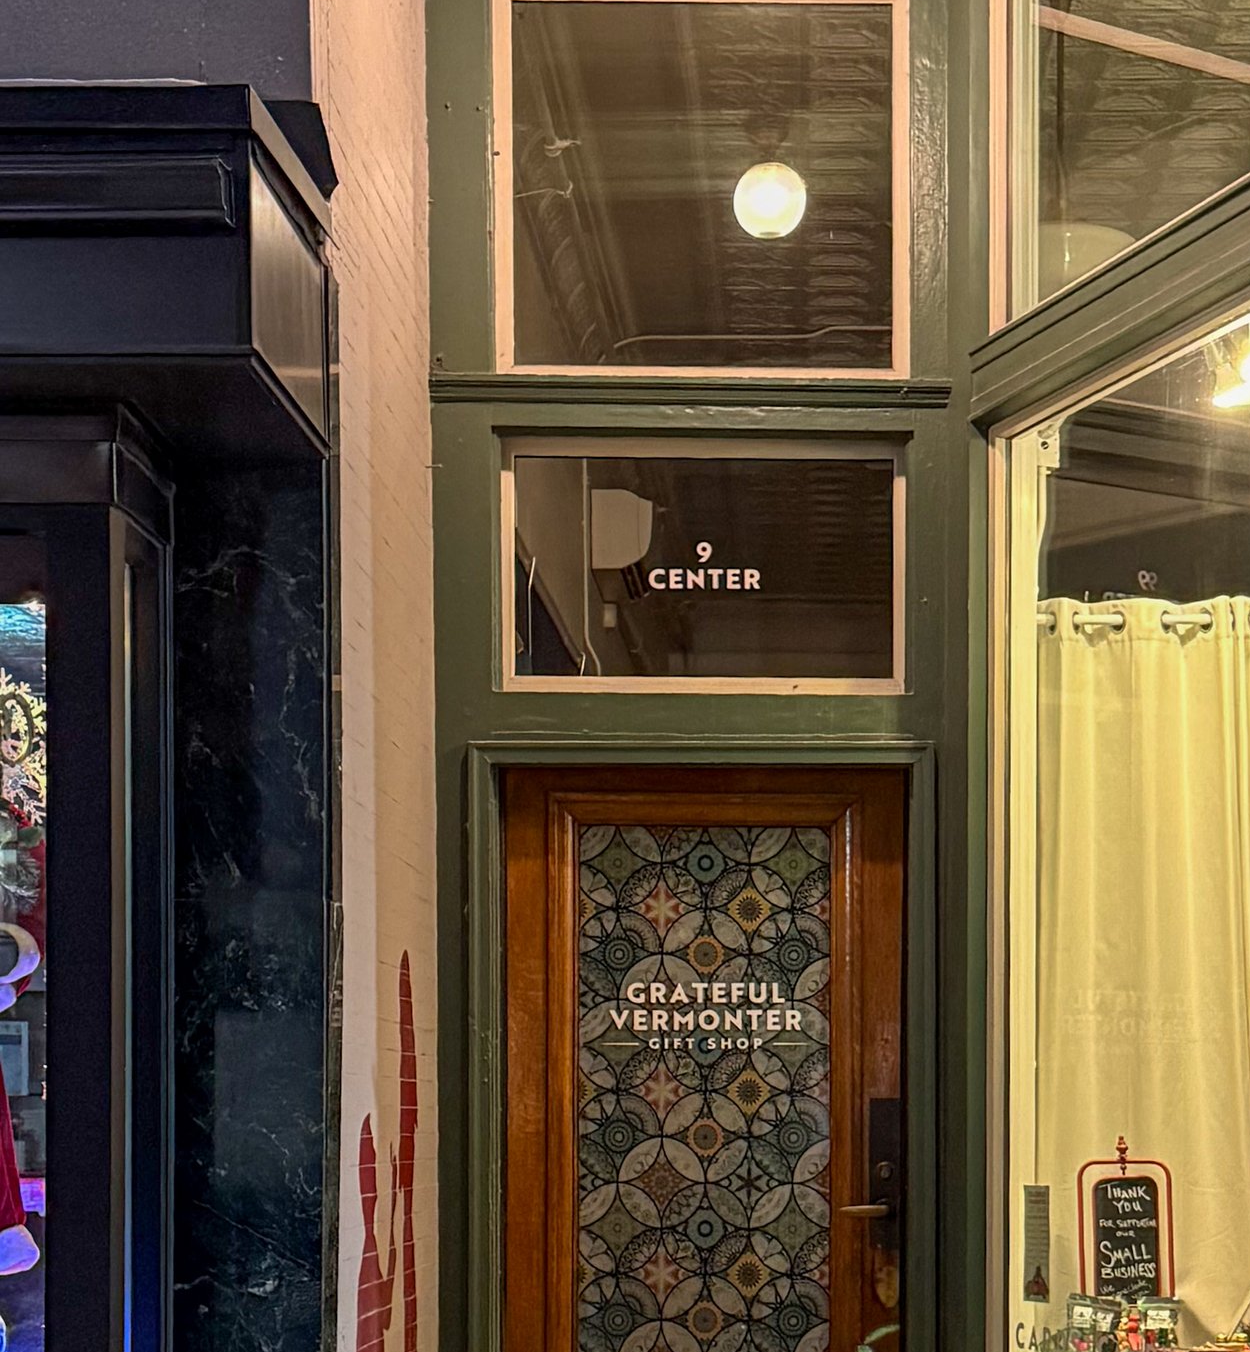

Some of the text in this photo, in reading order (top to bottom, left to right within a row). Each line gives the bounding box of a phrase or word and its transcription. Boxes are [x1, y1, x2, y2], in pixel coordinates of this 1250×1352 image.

[695, 540, 712, 563] 9
[647, 567, 761, 591] CENTER
[626, 982, 786, 1004] GRATEFUL
[609, 1009, 803, 1031] VERMONTER
[649, 1037, 764, 1050] GIFT SHOP
[1099, 1181, 1152, 1201] THANK
[1112, 1200, 1143, 1214] YOU
[1100, 1240, 1152, 1268] SMALL
[1101, 1262, 1156, 1279] BUSINESS
